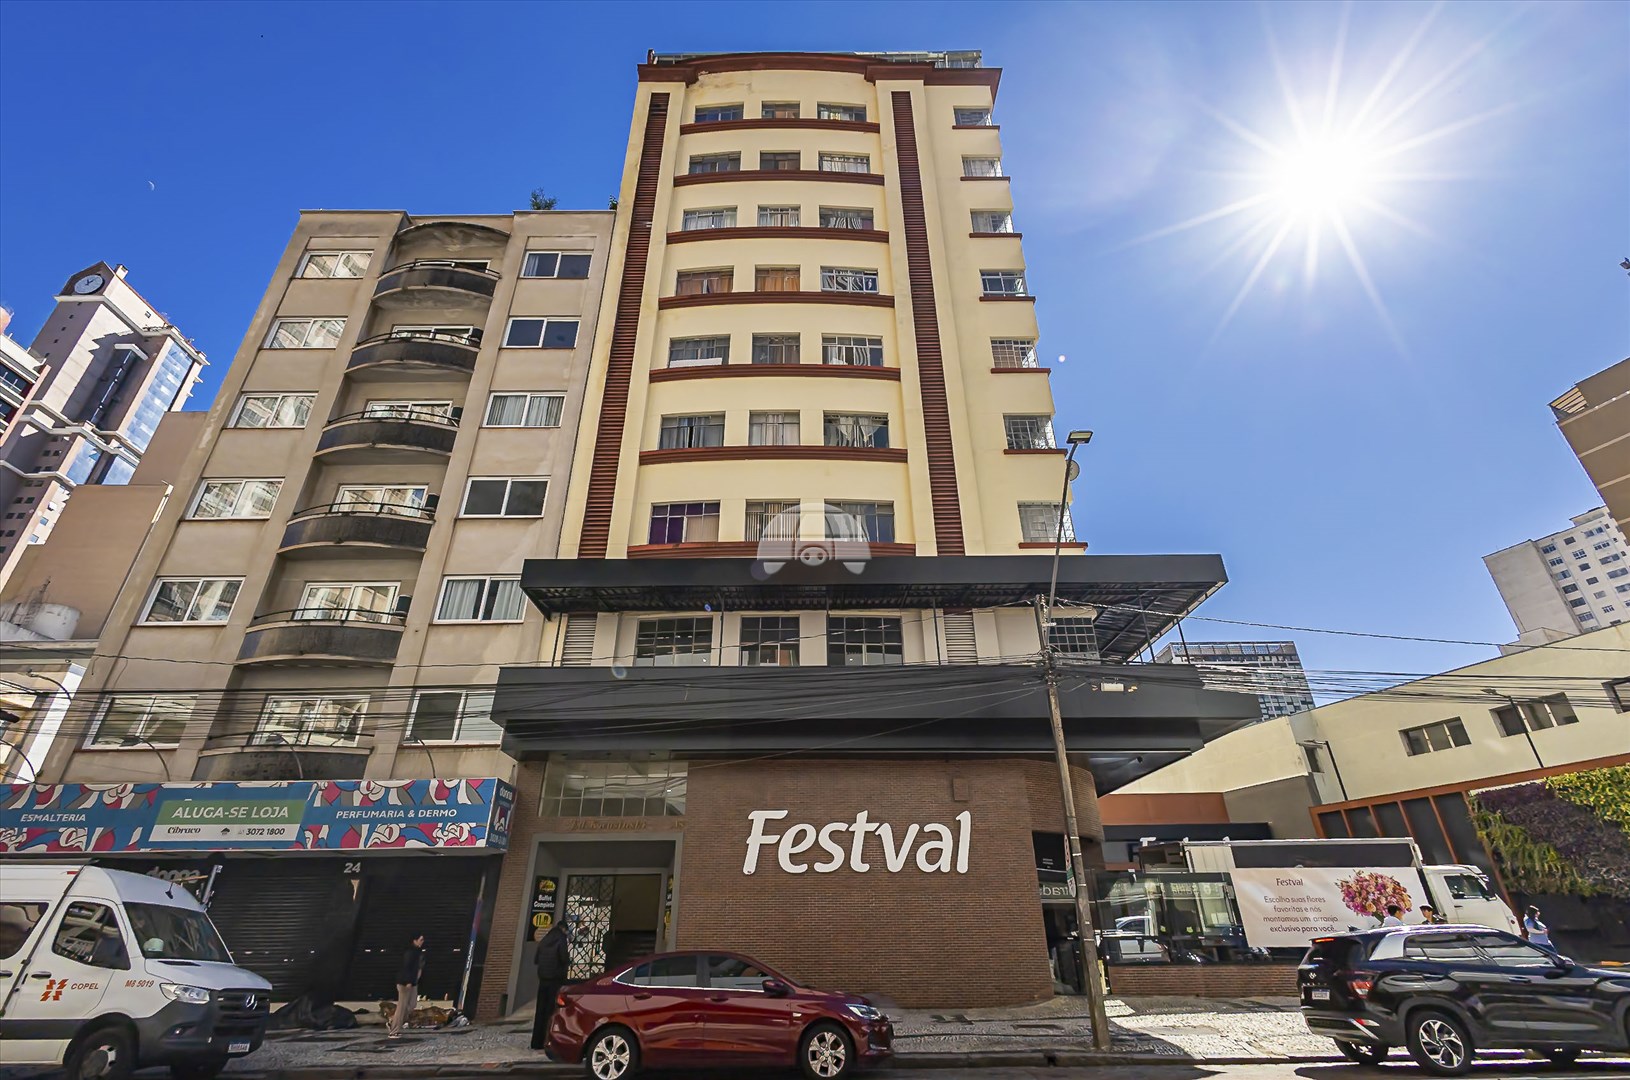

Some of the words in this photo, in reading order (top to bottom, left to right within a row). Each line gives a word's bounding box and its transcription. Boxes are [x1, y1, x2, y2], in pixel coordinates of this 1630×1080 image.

[171, 806, 249, 819] ALUGA-SE
[251, 806, 289, 818] LOJA
[336, 809, 405, 819] PERFUMARIA
[407, 809, 415, 818] &
[418, 808, 457, 818] DERMO
[20, 813, 86, 822] ESMALTERIA
[246, 828, 265, 836] 3072
[266, 827, 286, 836] 1800
[742, 809, 972, 875] Festval
[343, 862, 361, 874] 24
[1276, 878, 1304, 886] Festval
[1263, 895, 1291, 903] Escolha
[1306, 895, 1326, 903] flores
[1273, 905, 1304, 913] favoritas
[1309, 905, 1322, 913] nós
[1312, 914, 1339, 924] arranjo
[1269, 925, 1301, 933] exclusivo
[1301, 926, 1319, 934] para
[70, 982, 99, 990] COPEL
[136, 979, 155, 988] 5019
